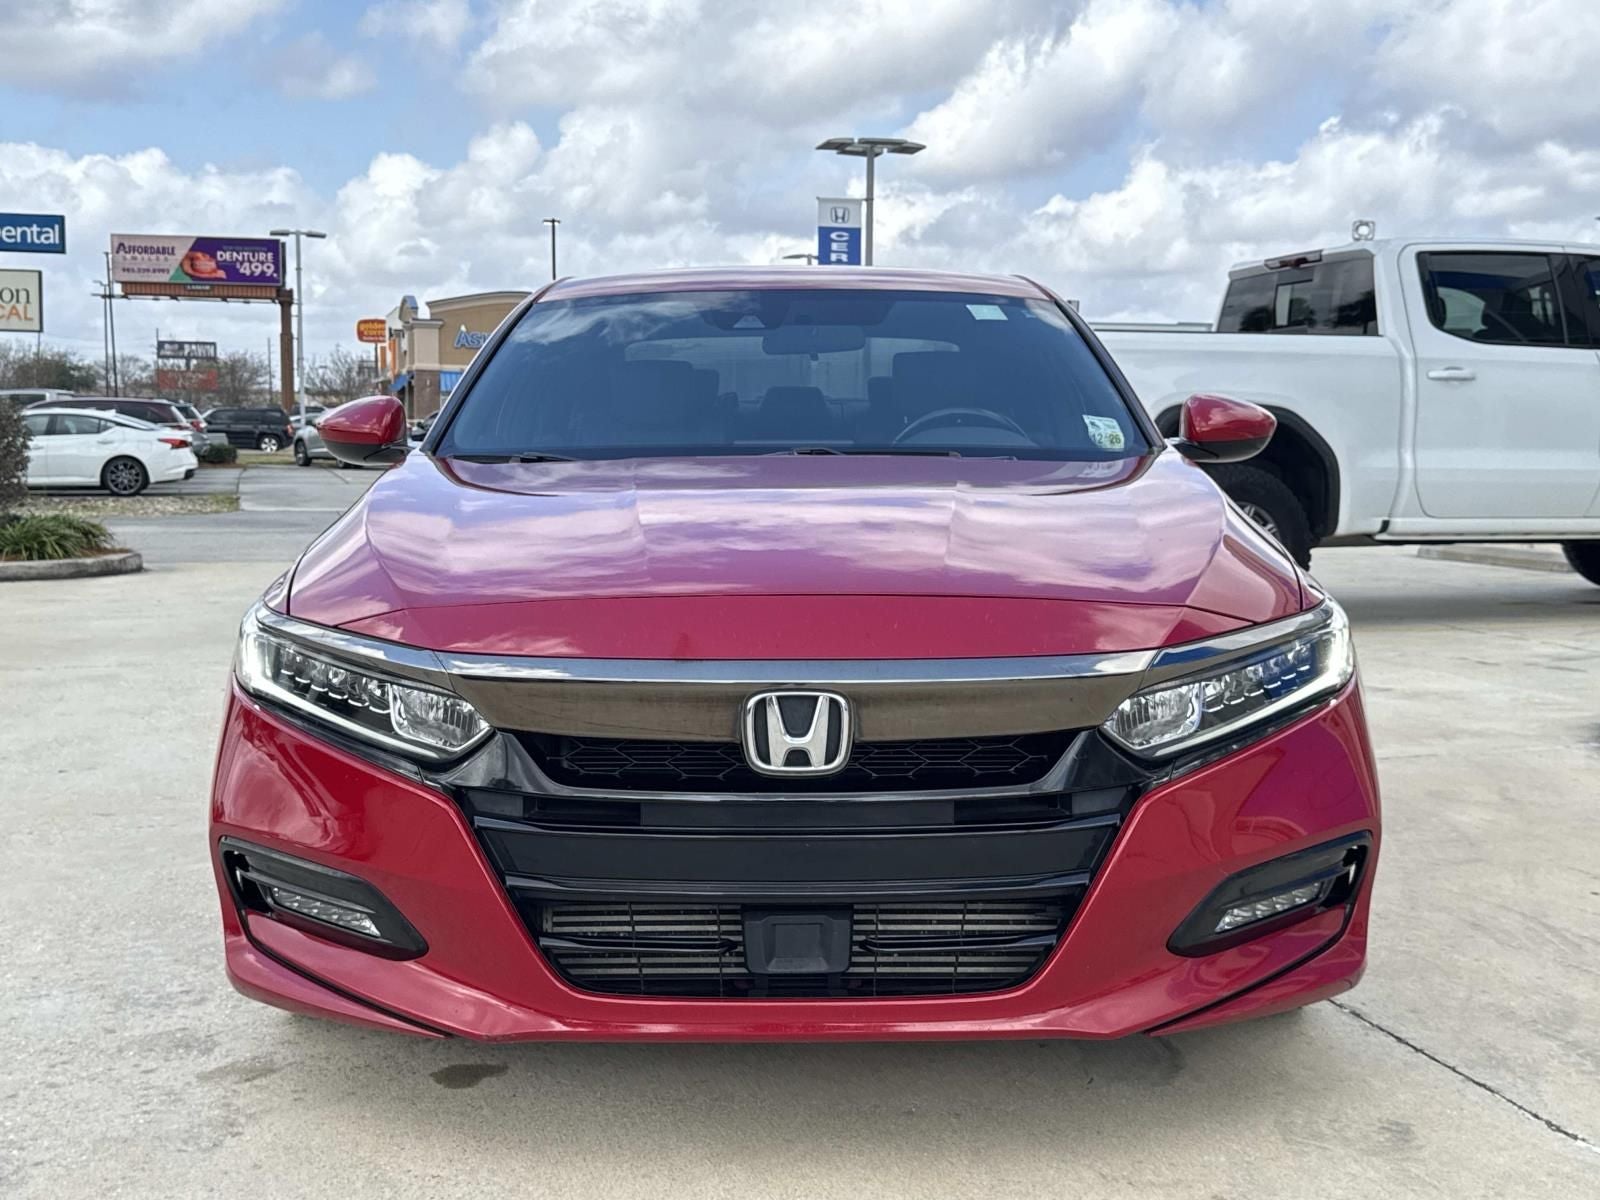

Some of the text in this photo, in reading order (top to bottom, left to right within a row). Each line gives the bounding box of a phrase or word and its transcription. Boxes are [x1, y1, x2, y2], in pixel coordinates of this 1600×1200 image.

[0, 224, 60, 245] ental
[116, 242, 176, 256] AFFORDABLE
[216, 250, 274, 263] DENTURE
[830, 231, 850, 265] CER
